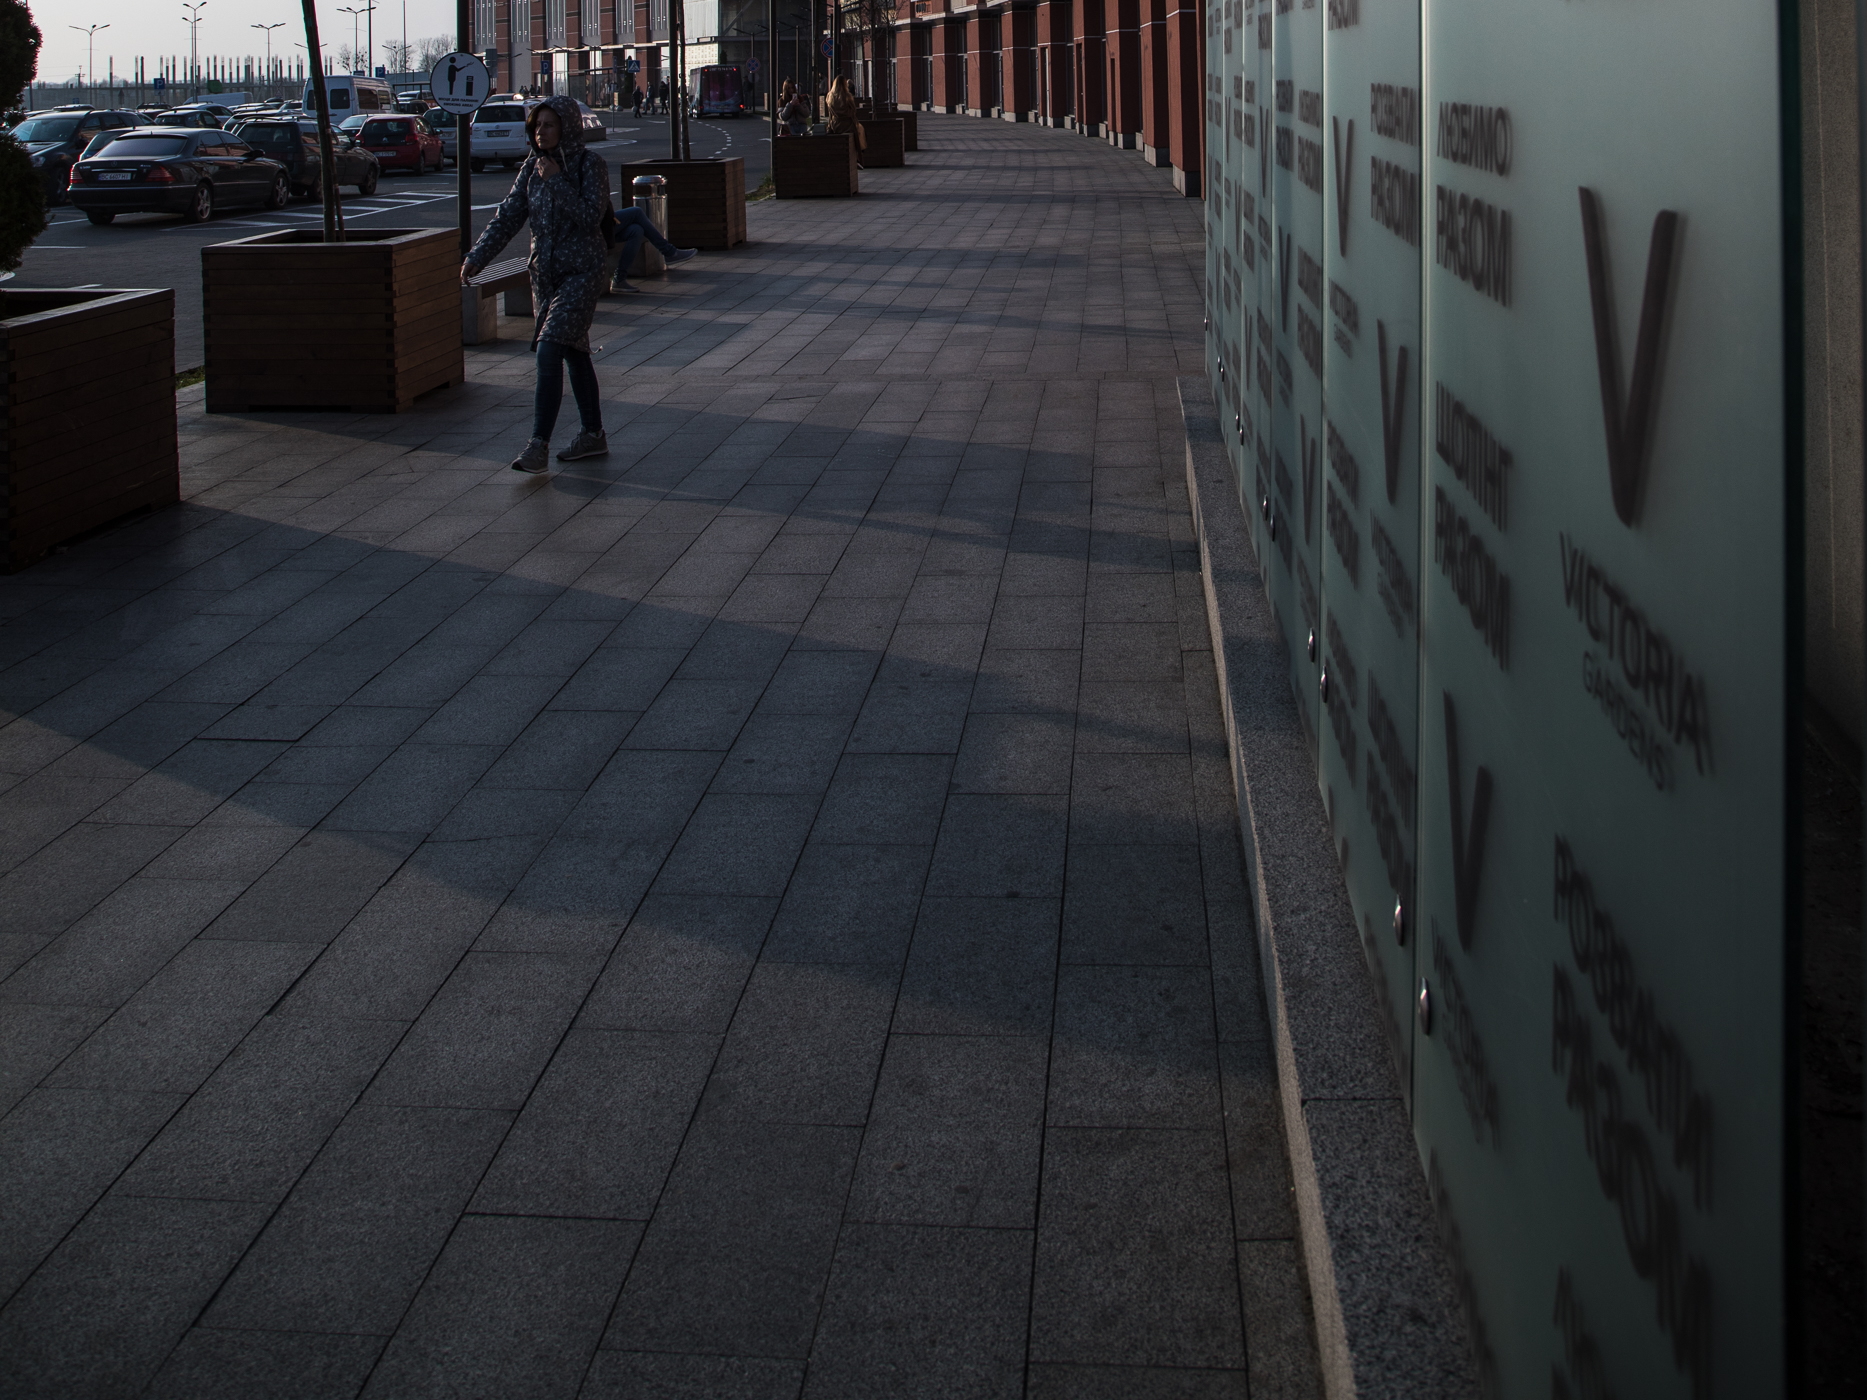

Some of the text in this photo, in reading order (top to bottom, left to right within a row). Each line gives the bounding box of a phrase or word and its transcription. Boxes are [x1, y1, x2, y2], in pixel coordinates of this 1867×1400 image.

[1332, 115, 1354, 257] V
[1436, 102, 1512, 176] ЛЮБИМО
[1436, 184, 1511, 307] РАЗОМ
[1377, 319, 1409, 505] V
[1578, 185, 1686, 529] V
[1435, 482, 1510, 673] РАЗОМ
[1559, 531, 1713, 777] VICTORIA
[1443, 688, 1493, 953] V
